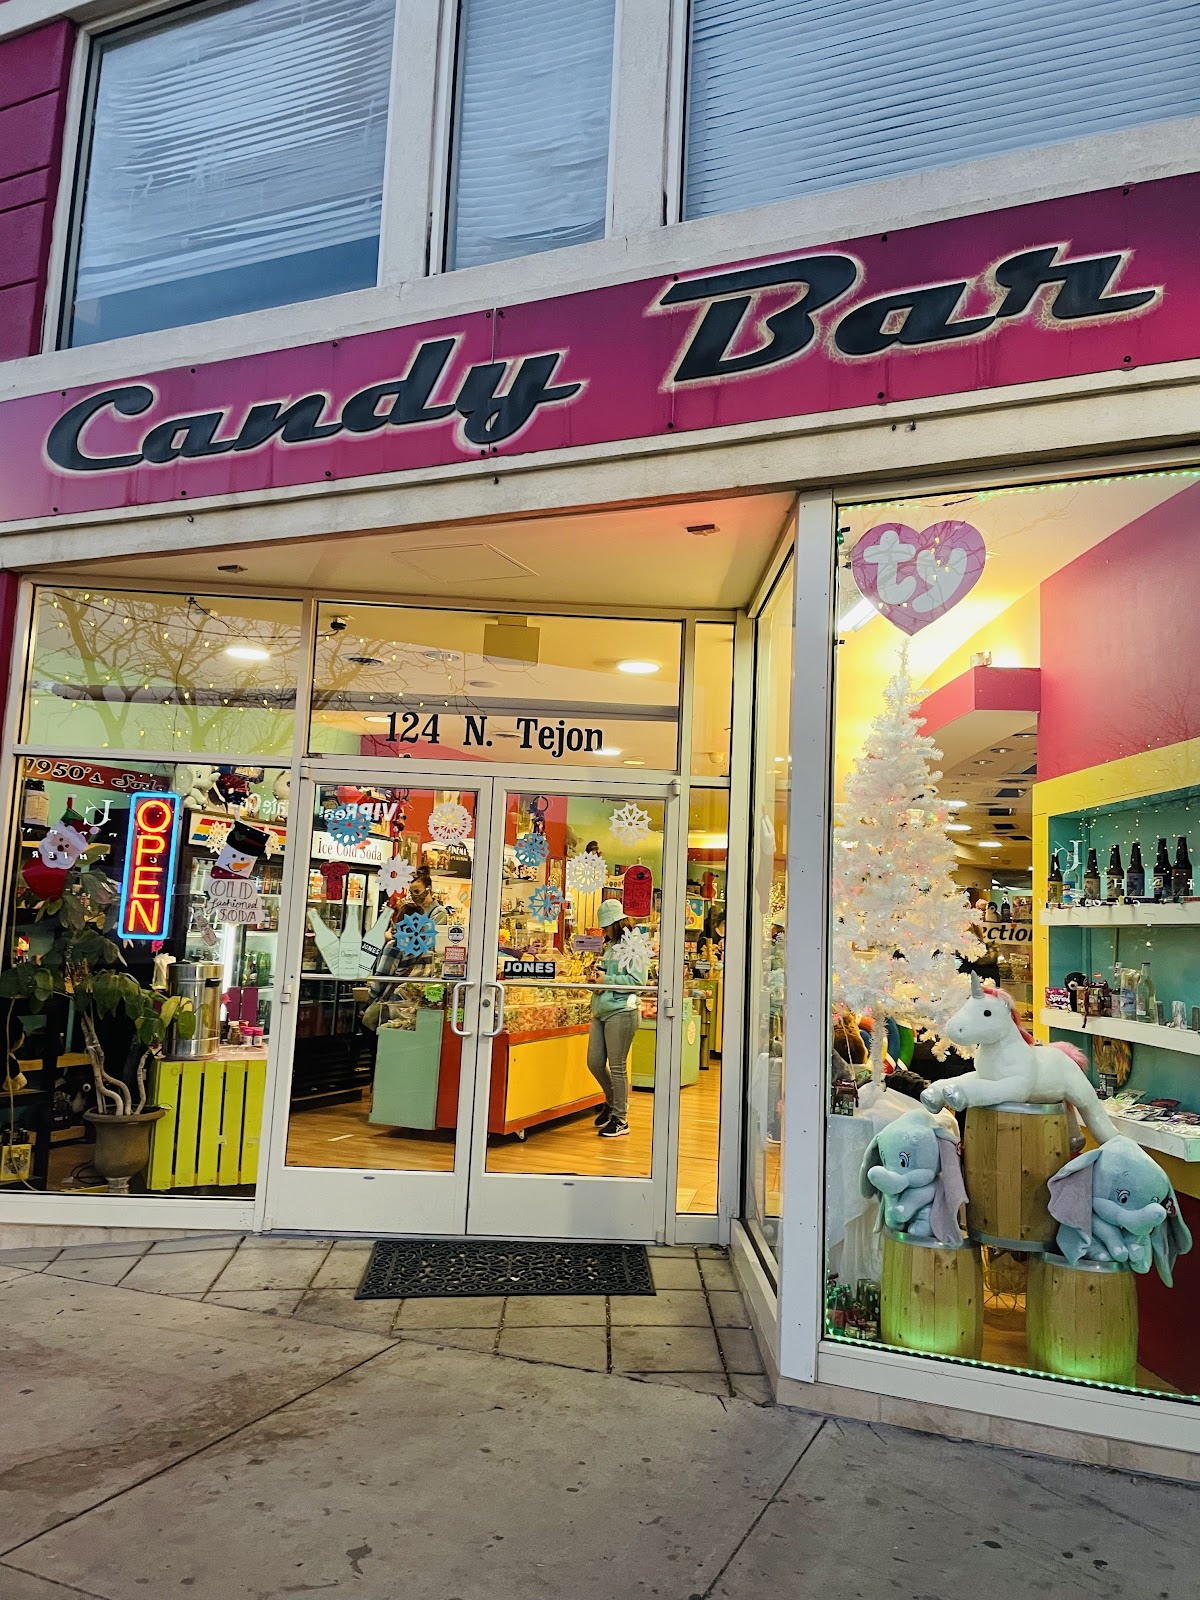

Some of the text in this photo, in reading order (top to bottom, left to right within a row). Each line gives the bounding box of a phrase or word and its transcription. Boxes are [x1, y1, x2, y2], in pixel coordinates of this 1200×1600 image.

[44, 243, 1163, 474] Candy Bar
[863, 530, 968, 612] ty
[386, 711, 605, 758] 124 N. Tejon
[26, 757, 105, 785] 1950's
[127, 800, 172, 933] OPEN
[210, 880, 253, 899] OLD
[219, 908, 257, 922] SODA
[504, 961, 555, 973] JONES
